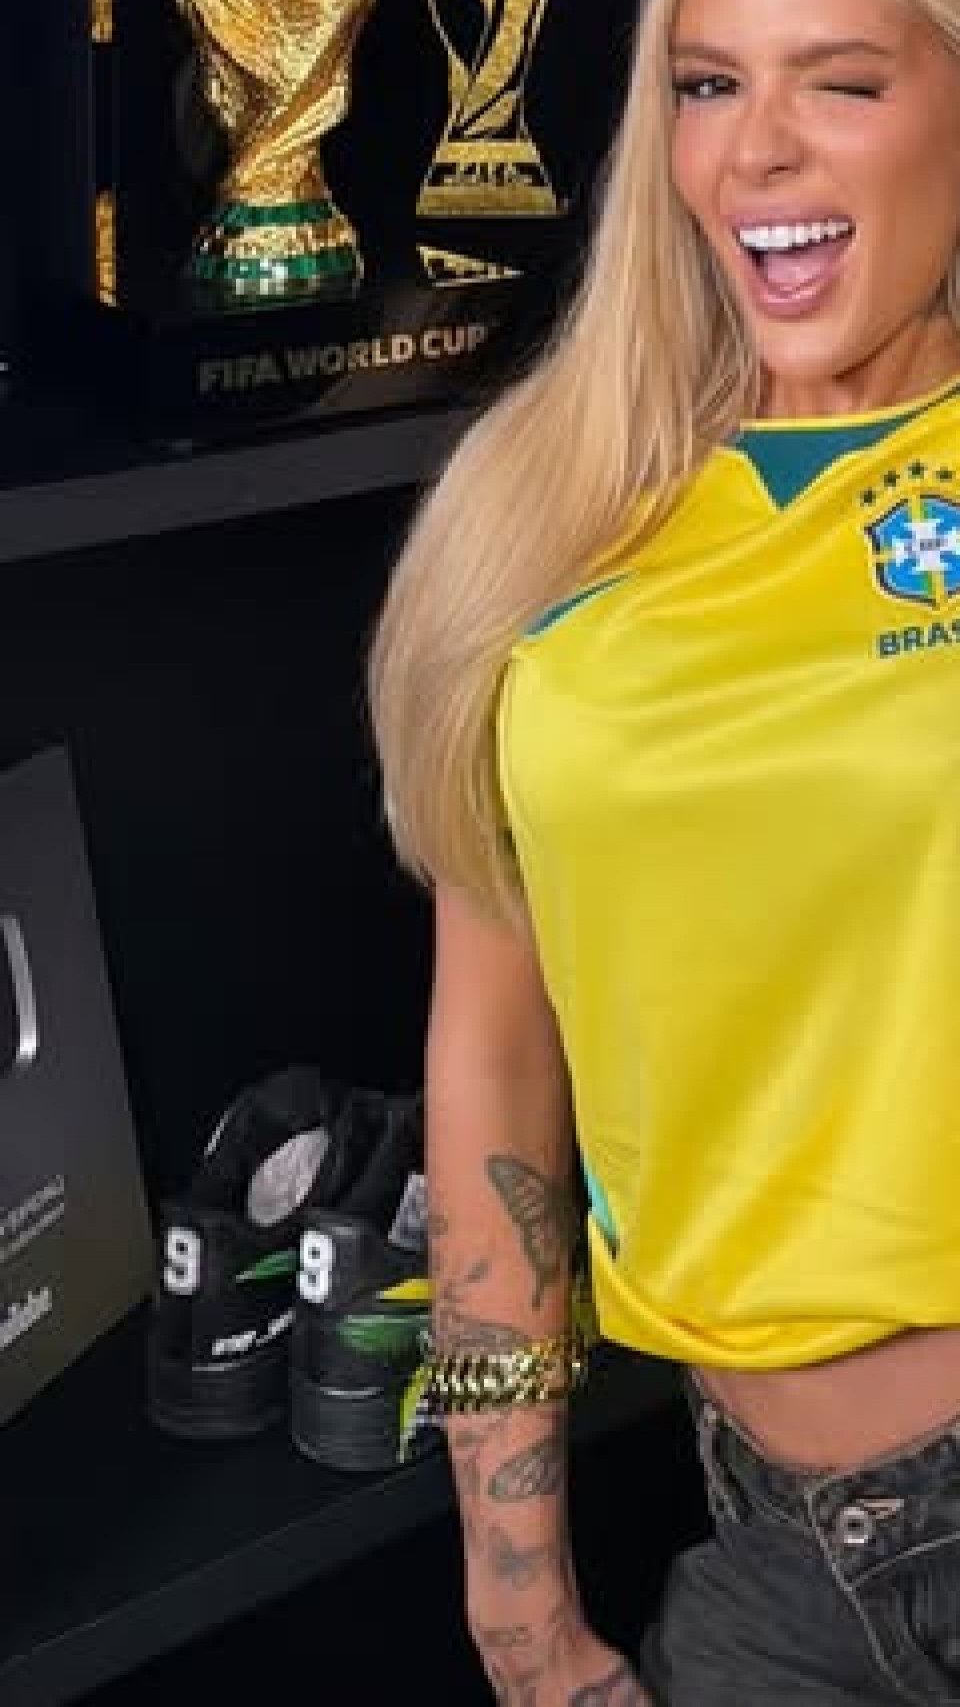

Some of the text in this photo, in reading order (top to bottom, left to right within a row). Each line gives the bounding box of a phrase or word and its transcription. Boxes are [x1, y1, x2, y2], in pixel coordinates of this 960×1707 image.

[198, 324, 487, 392] FIFA WORLD CUP
[163, 1226, 202, 1295] 9
[296, 1229, 335, 1305] 9
